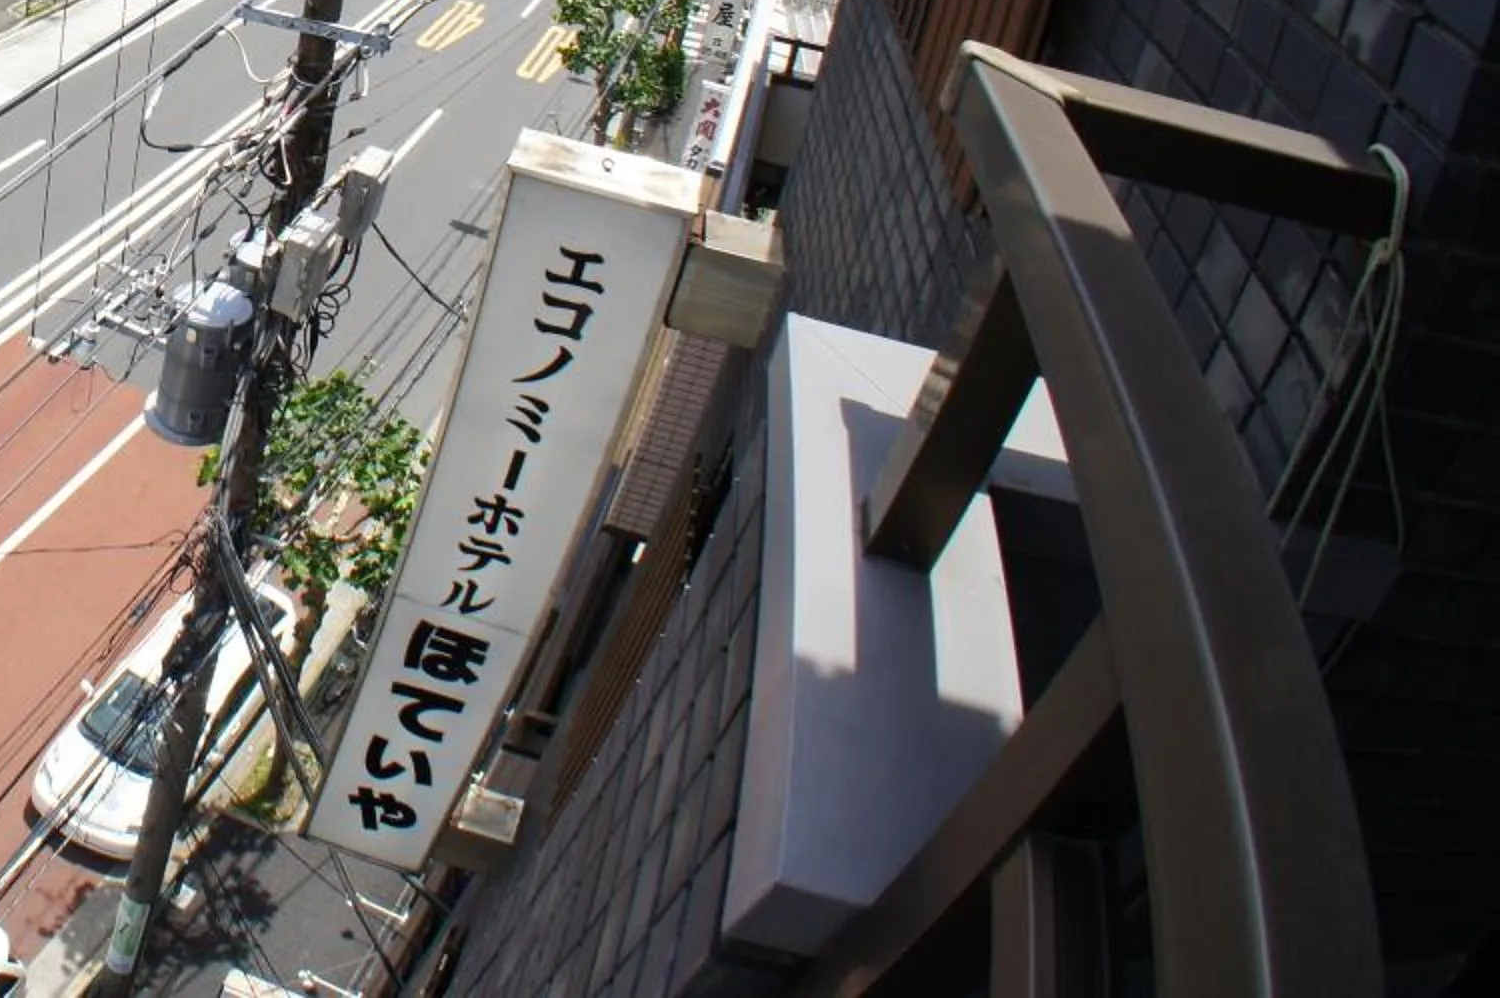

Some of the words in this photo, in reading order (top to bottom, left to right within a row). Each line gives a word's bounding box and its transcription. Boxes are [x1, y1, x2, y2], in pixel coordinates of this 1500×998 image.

[441, 244, 606, 617] エコノミーホテル
[348, 618, 491, 832] ほていや
